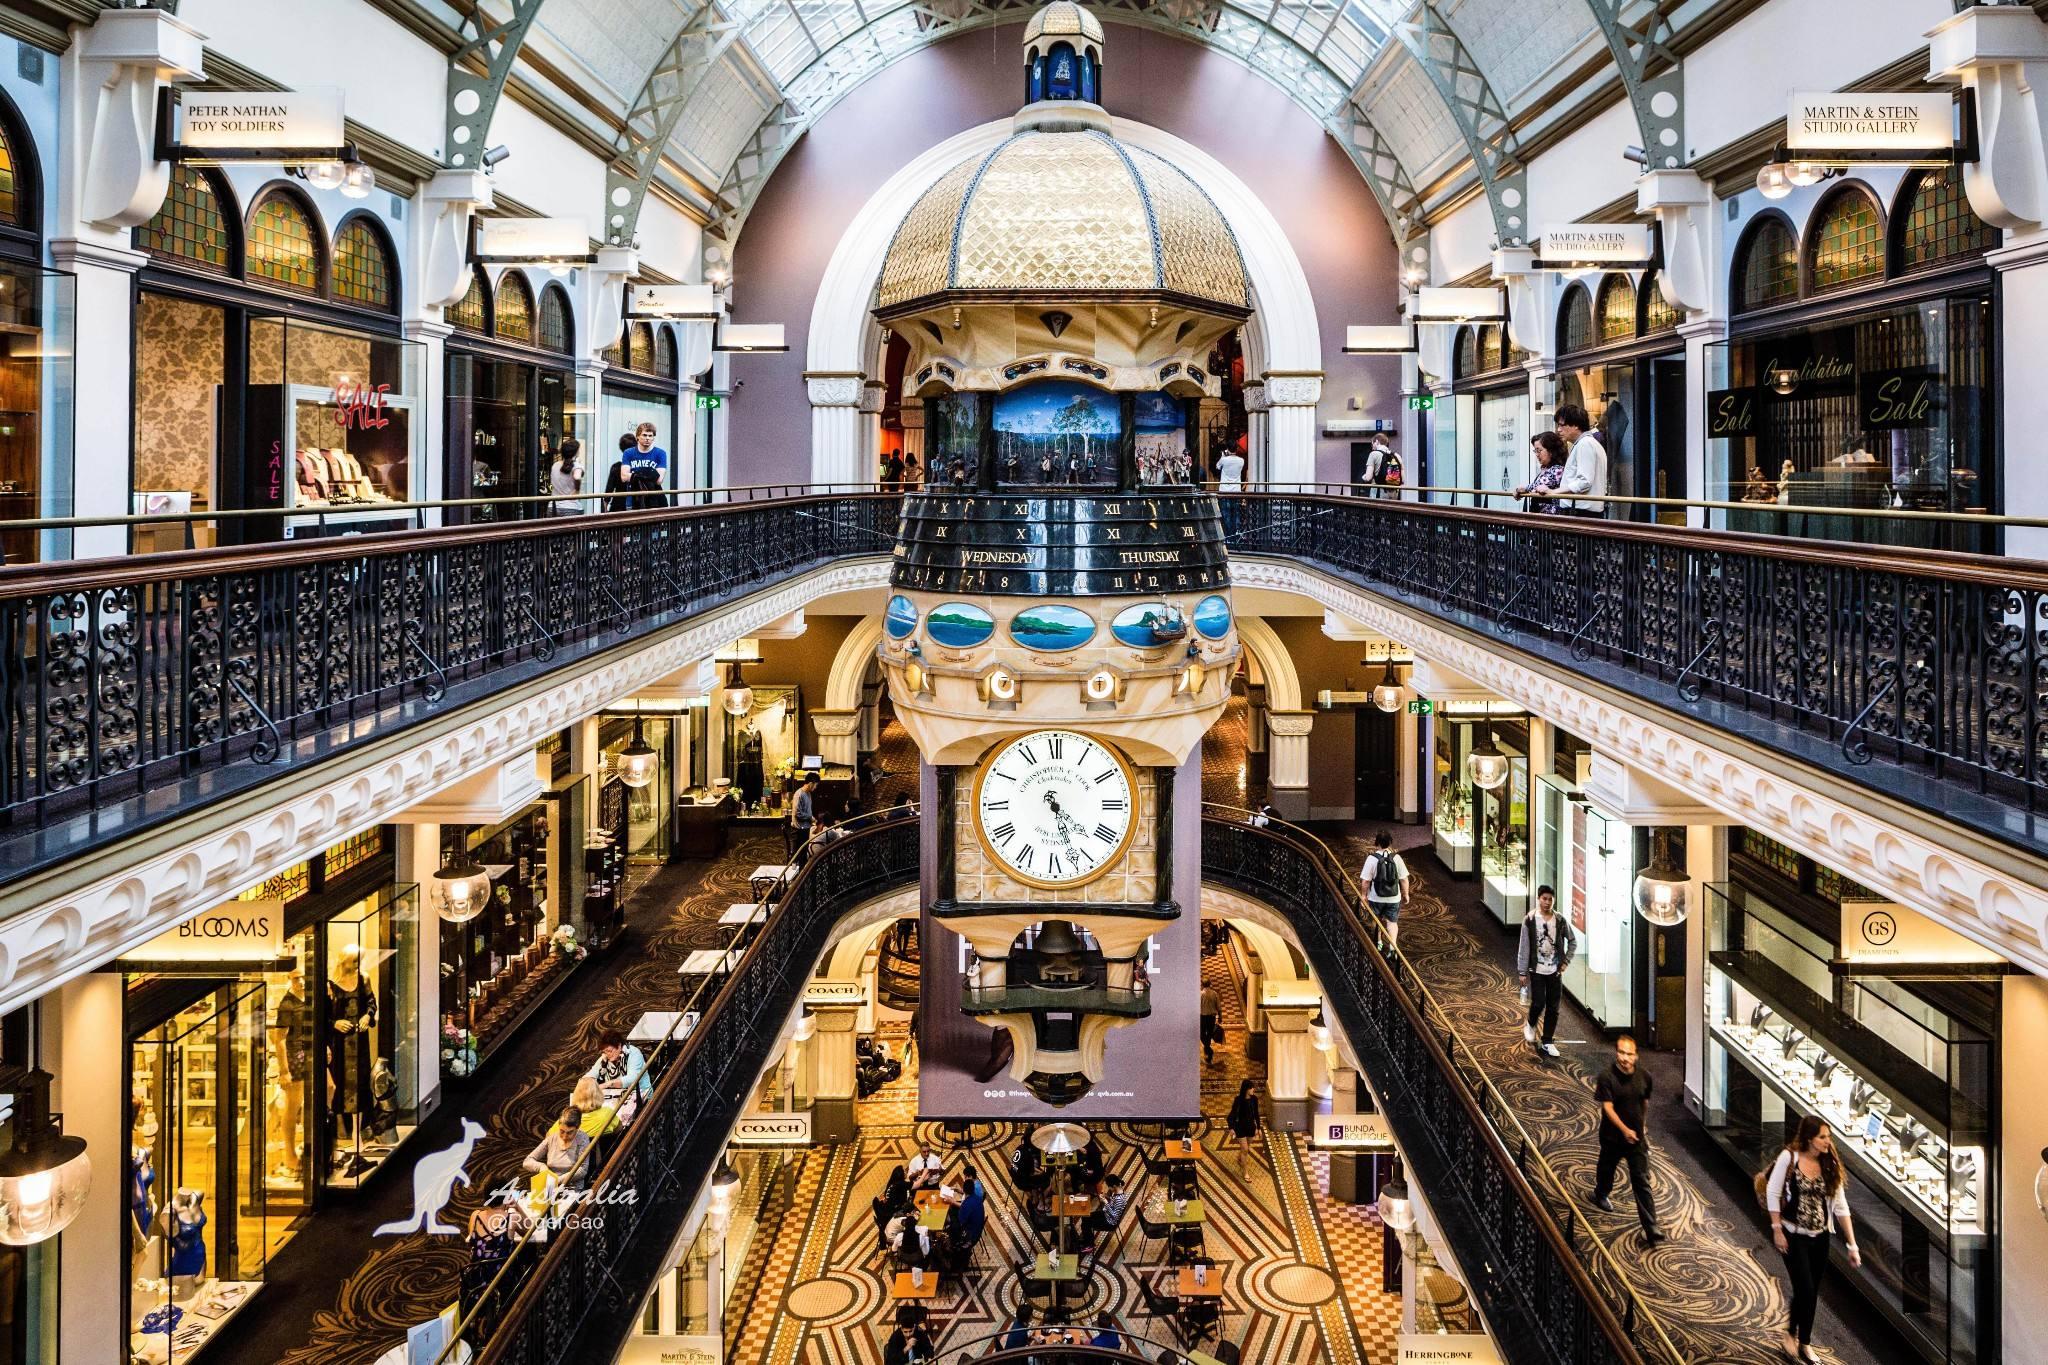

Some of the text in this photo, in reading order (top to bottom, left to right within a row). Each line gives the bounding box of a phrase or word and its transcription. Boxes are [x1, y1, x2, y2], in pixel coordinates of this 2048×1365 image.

[189, 106, 287, 116] PETER NATHAN
[1804, 107, 1918, 118] MARTIN & STEIN
[190, 121, 285, 132] TOY SOLDIERS
[1804, 121, 1918, 133] STUDIO GALLERY
[1550, 233, 1625, 241] MARTIN & STEIN
[1550, 242, 1625, 251] STUDIO GALLERY
[1763, 354, 1853, 386] Cosolidation
[334, 382, 391, 430] SALE
[1869, 377, 1929, 423] Sale
[1712, 395, 1751, 432] Sale
[269, 440, 281, 499] SALE
[940, 503, 949, 513] X
[1014, 504, 1028, 514] XI
[1104, 503, 1121, 514] XII
[936, 526, 1194, 539] IX X XI XII
[961, 550, 1180, 563] WEDNESDAY THURSDAY
[937, 571, 944, 584] 6
[966, 575, 974, 586] 7
[1001, 576, 1008, 587] 8
[1114, 577, 1123, 588] 11
[1149, 576, 1159, 587] 12
[1178, 574, 1187, 585] 13
[1201, 572, 1208, 583] 14
[1048, 738, 1063, 760] XII
[1101, 800, 1123, 811] III
[179, 917, 269, 937] BLOOMS
[1868, 921, 1889, 936] GS
[1097, 1090, 1134, 1098] qvb.com.au
[741, 1125, 799, 1133] COACH
[1344, 1132, 1389, 1141] BOUTIQUE
[1405, 1350, 1473, 1359] HERRINGBONE
